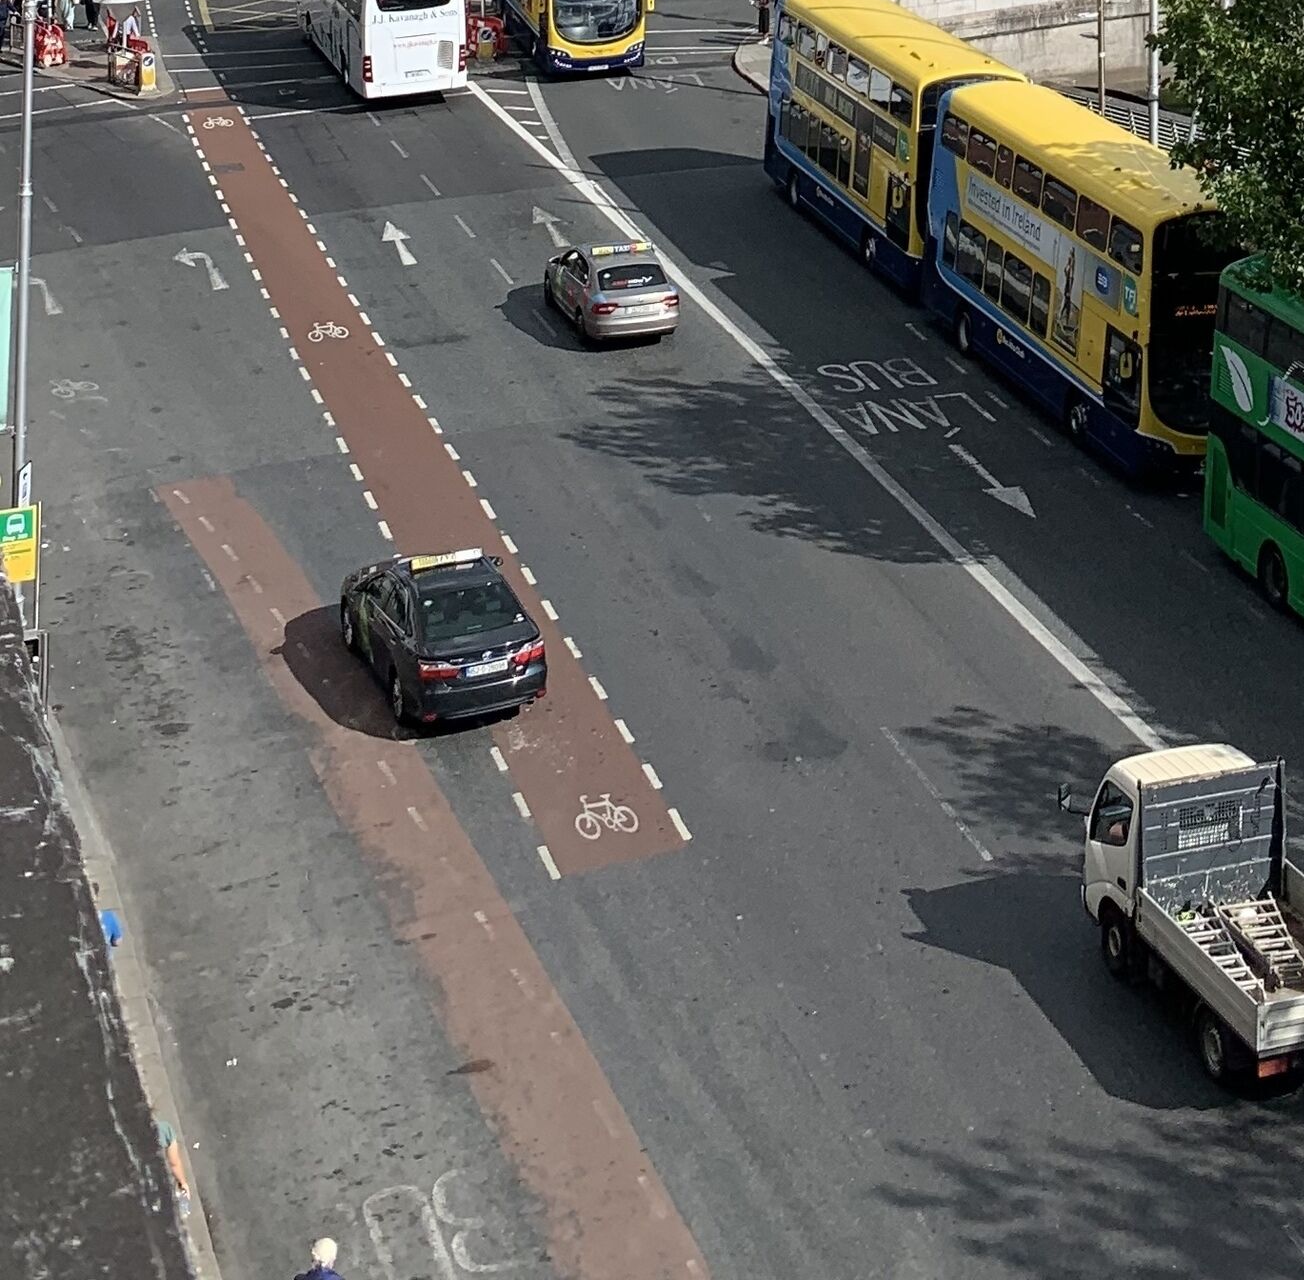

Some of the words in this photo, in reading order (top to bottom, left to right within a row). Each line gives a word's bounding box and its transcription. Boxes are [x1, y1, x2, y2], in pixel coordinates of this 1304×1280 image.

[388, 11, 428, 23] Kavanagh
[440, 8, 458, 18] Sons
[969, 175, 1001, 213] Invested
[1012, 204, 1042, 241] Ireland
[817, 357, 938, 392] BUS
